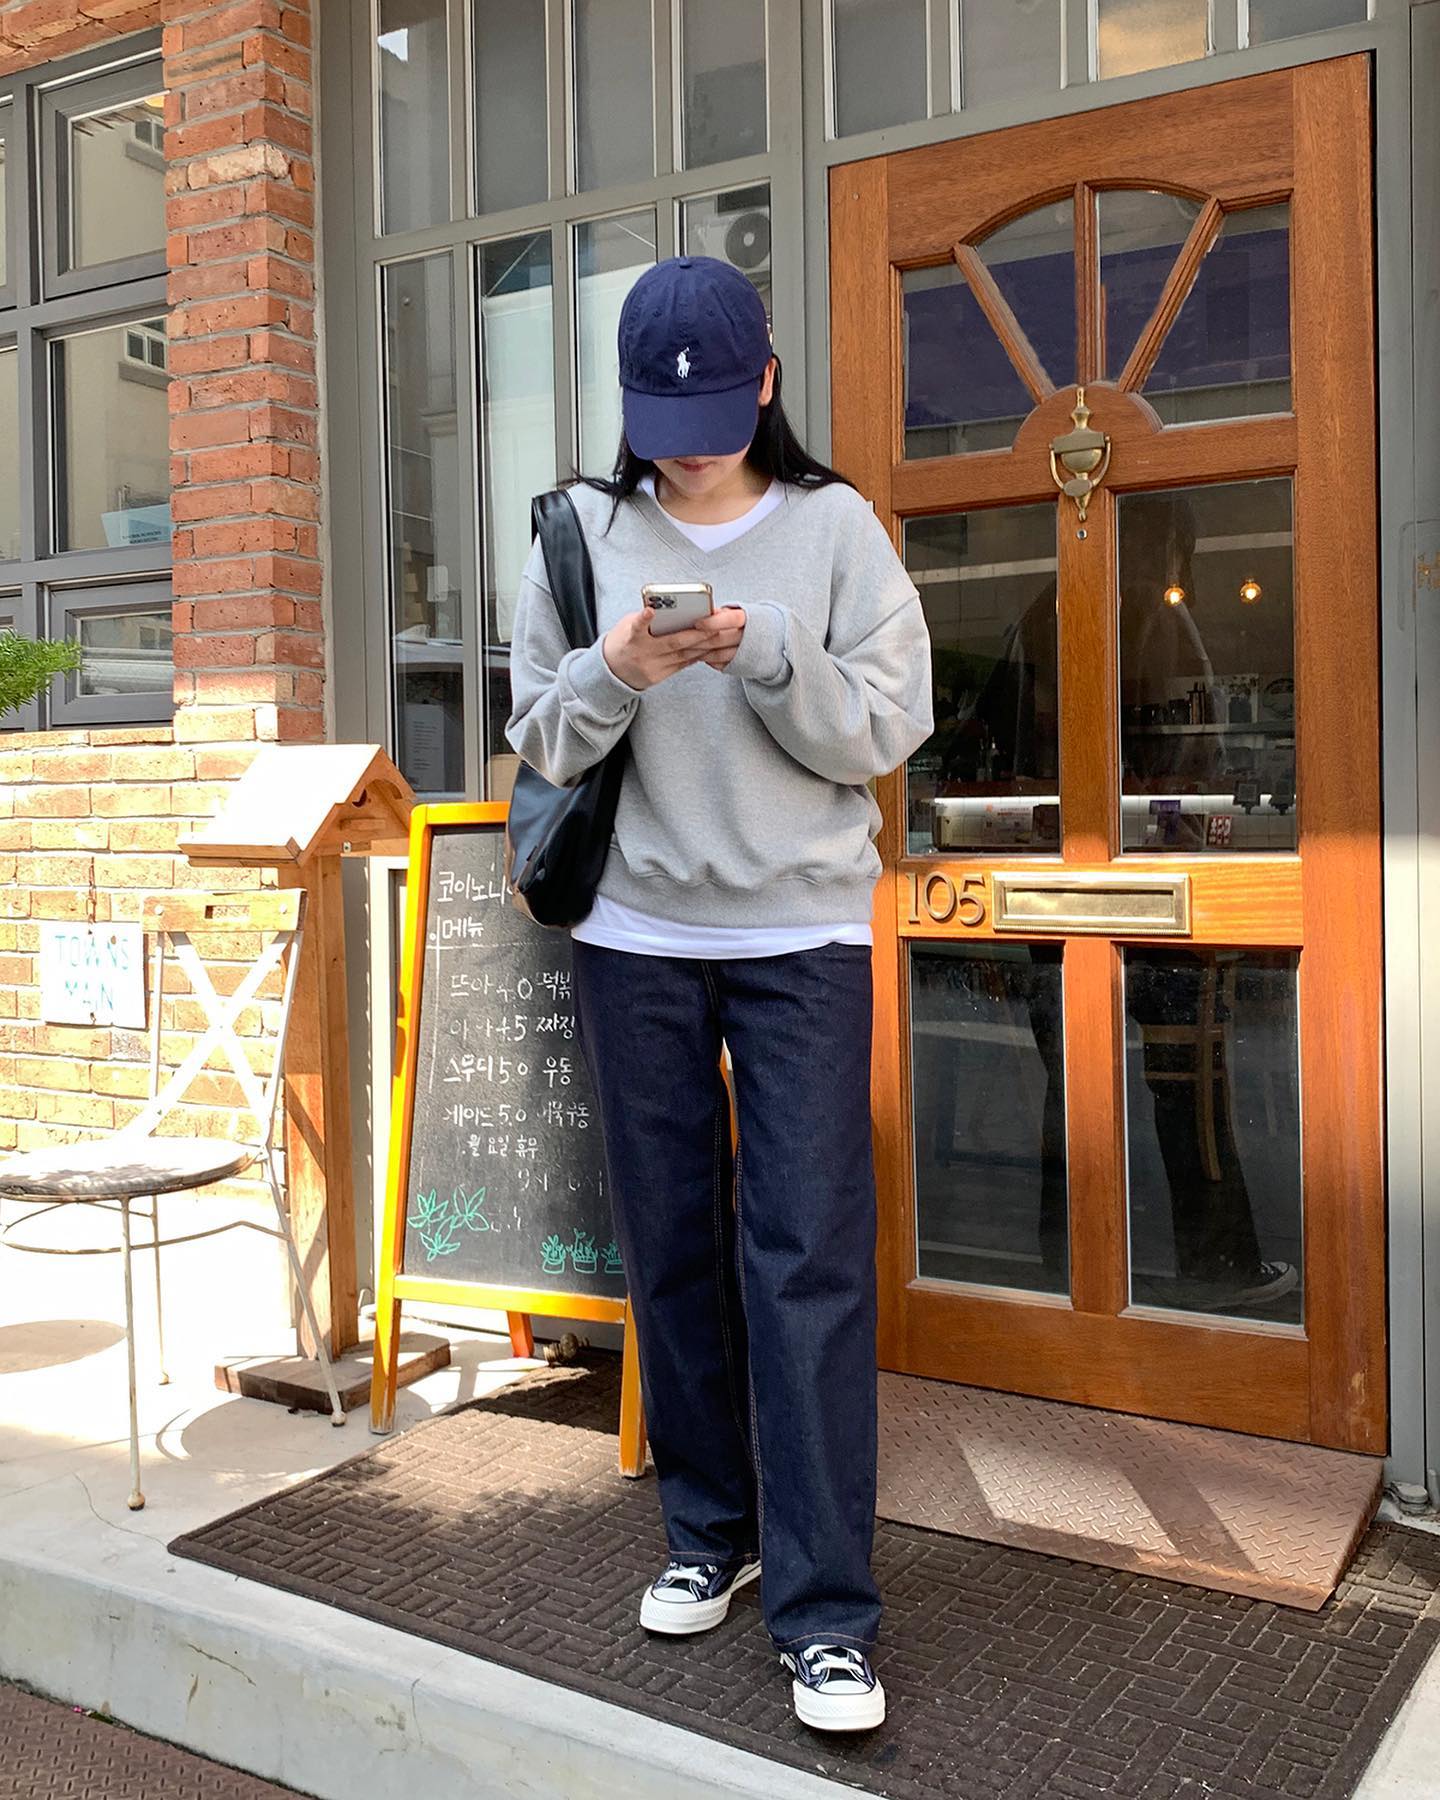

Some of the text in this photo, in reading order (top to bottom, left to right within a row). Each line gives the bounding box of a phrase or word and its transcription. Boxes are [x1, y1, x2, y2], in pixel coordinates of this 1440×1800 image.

[437, 871, 513, 905] 코이노니
[904, 870, 985, 926] 105
[442, 916, 484, 939] 메뉴
[443, 1054, 493, 1083] 스무디
[543, 1056, 573, 1088] 우동
[515, 1134, 538, 1159] 휴무
